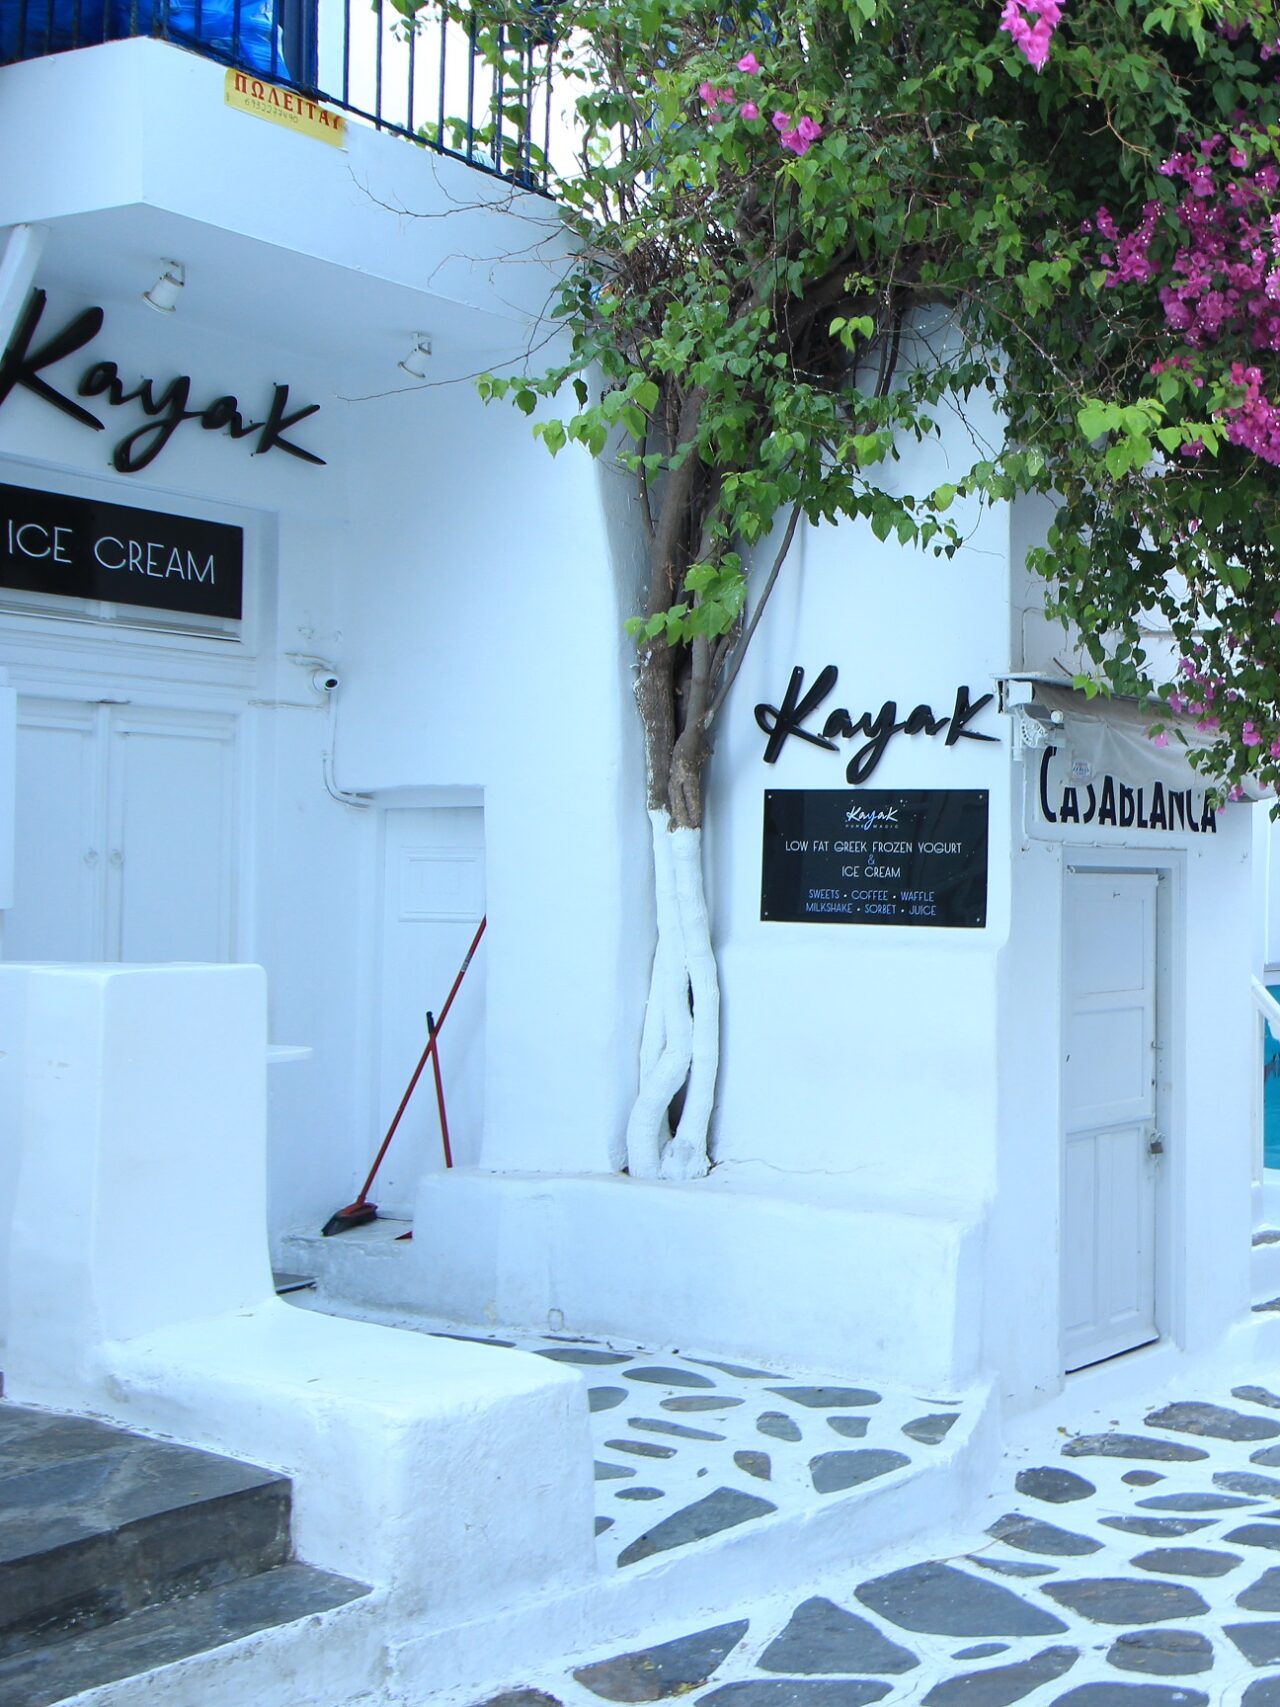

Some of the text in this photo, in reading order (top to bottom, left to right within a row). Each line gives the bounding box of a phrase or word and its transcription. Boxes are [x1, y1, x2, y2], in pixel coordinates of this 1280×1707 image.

[0, 287, 327, 473] Kayak
[8, 519, 215, 585] ICE CREAM
[754, 664, 1001, 785] Kayak
[845, 806, 899, 831] Kayak
[785, 840, 962, 854] LOW FAT GREEK FROZEN YOGURT
[867, 854, 875, 865] &
[841, 866, 901, 878] ICE CREAM
[808, 889, 935, 902] SWEETS COFFEE WAFFLE
[805, 902, 937, 916] MILKSHAKE SORBET JUICE
